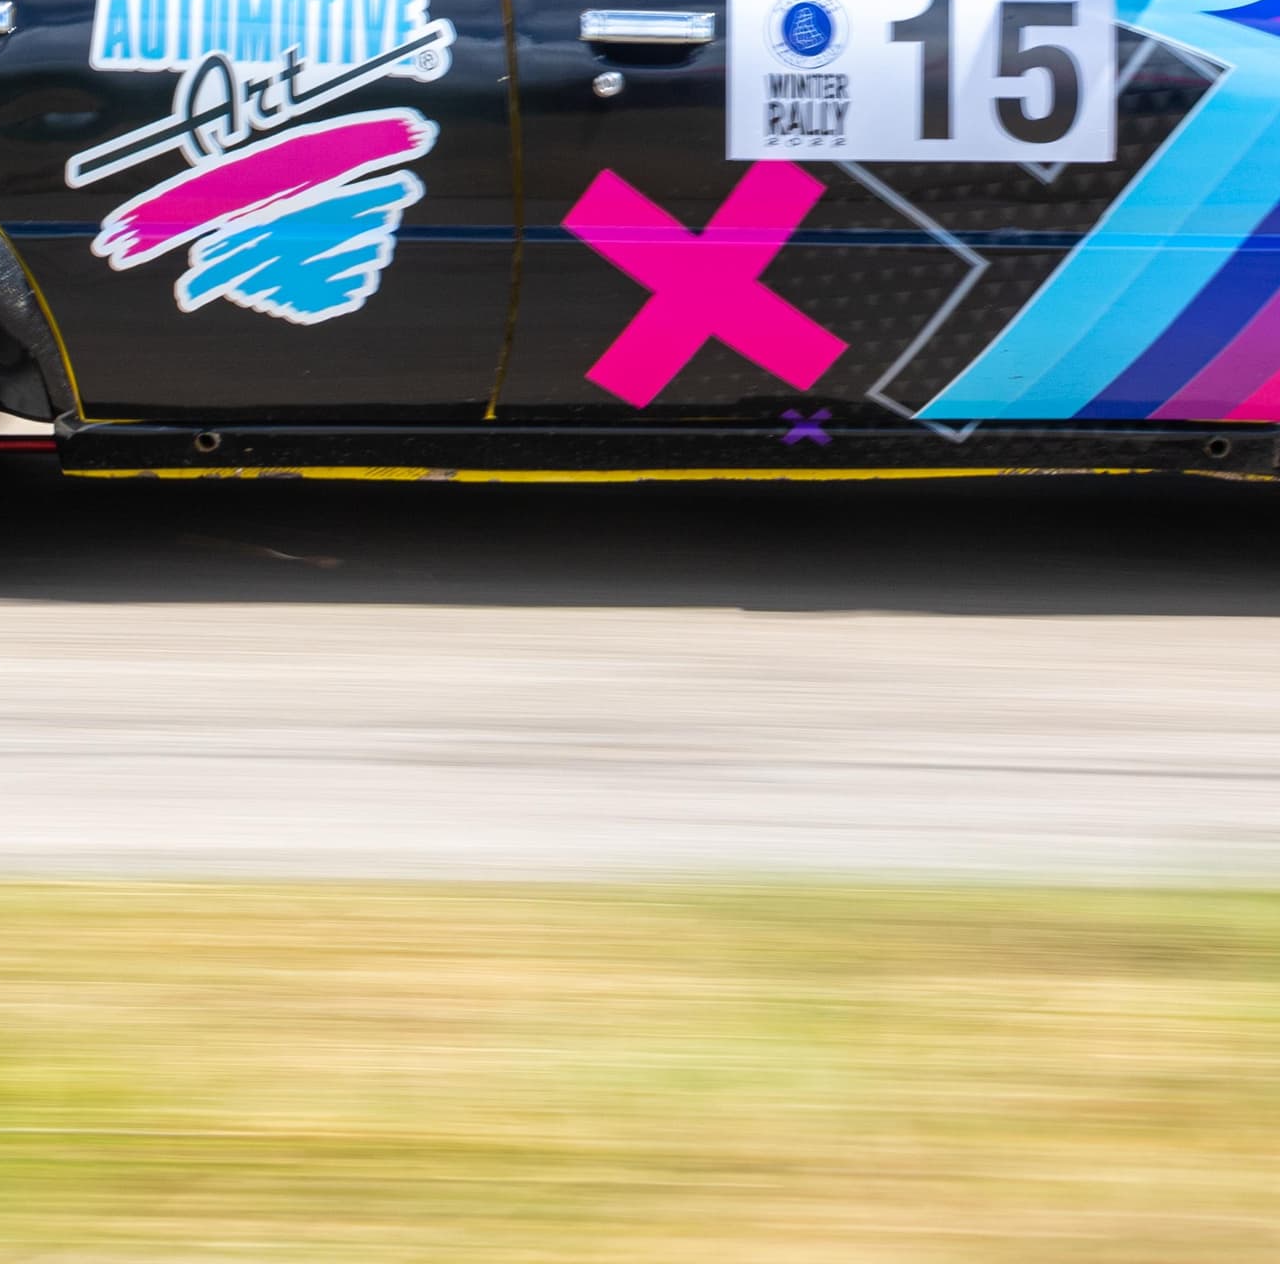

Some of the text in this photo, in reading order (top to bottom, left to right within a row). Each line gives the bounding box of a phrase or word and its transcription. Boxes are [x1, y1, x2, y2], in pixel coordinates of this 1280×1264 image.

[765, 74, 850, 99] WINTER
[765, 101, 850, 136] RALLY
[765, 137, 848, 147] 2022
